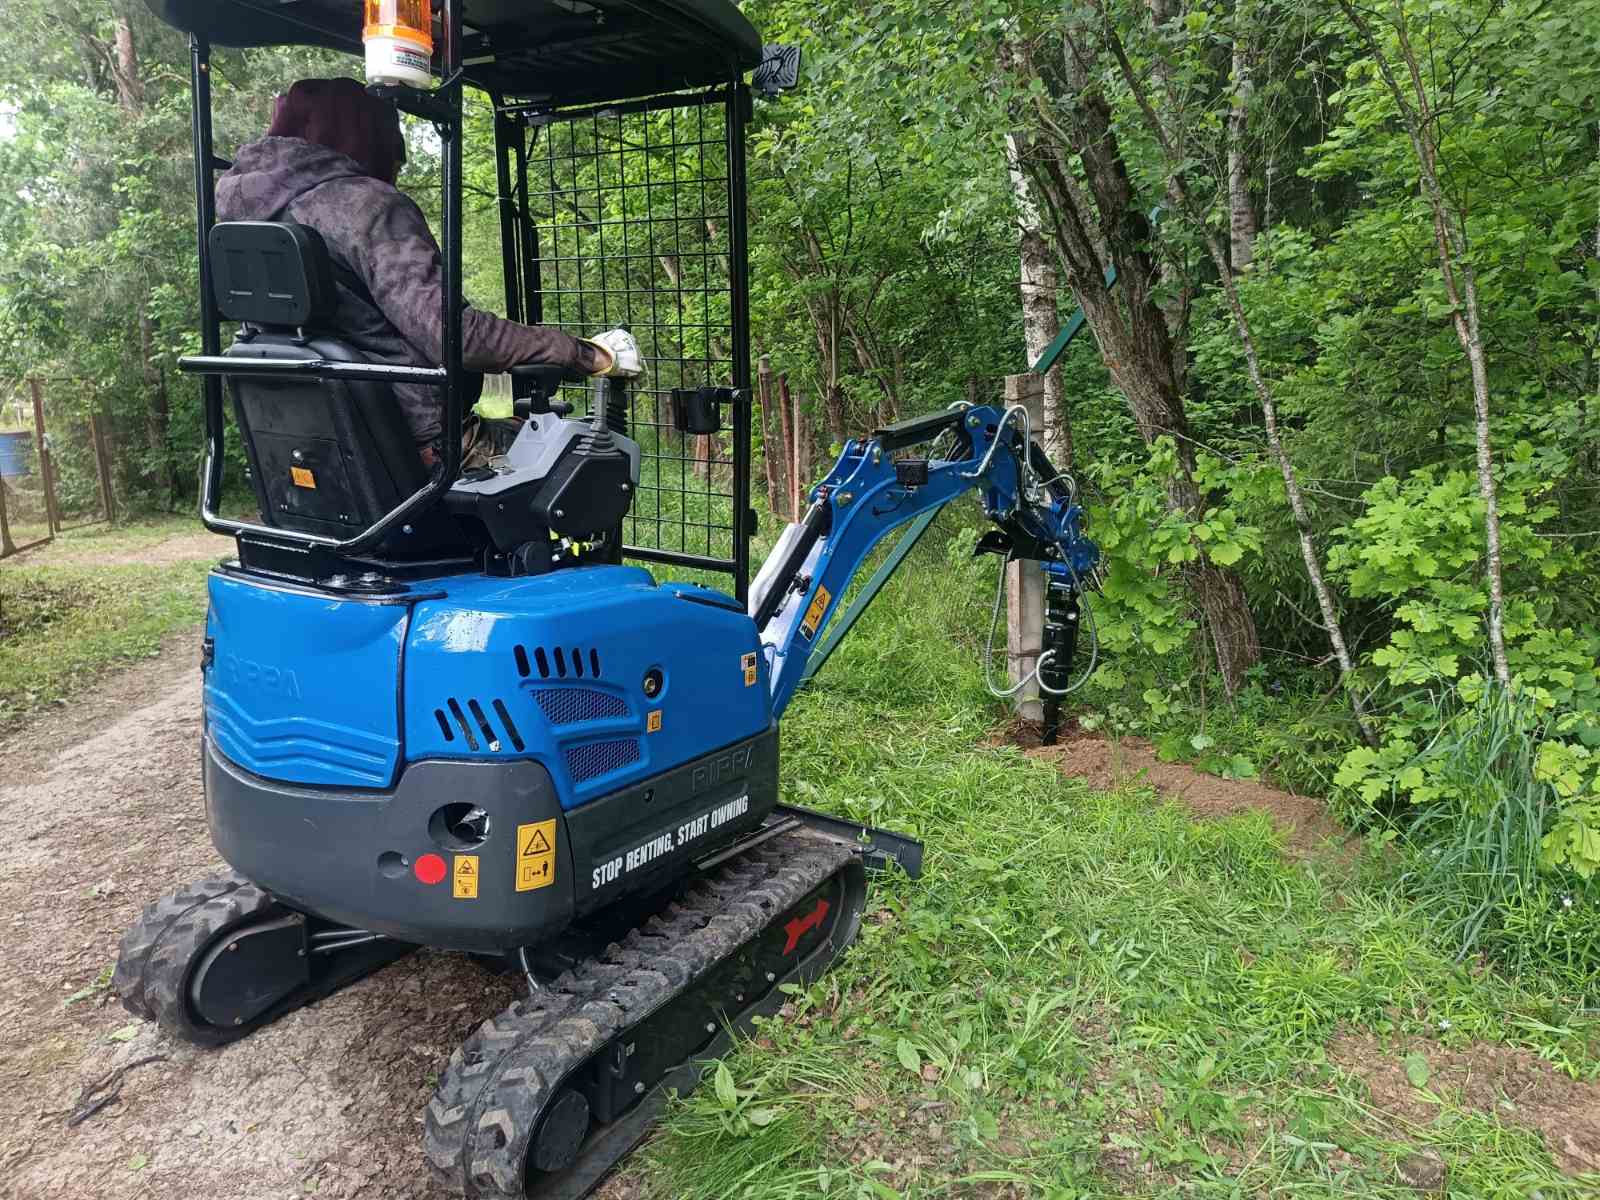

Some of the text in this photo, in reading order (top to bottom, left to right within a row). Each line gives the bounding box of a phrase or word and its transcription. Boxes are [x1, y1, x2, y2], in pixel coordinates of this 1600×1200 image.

[225, 652, 302, 698] RPPA
[592, 794, 749, 889] STOP RENTING, START OWNING
